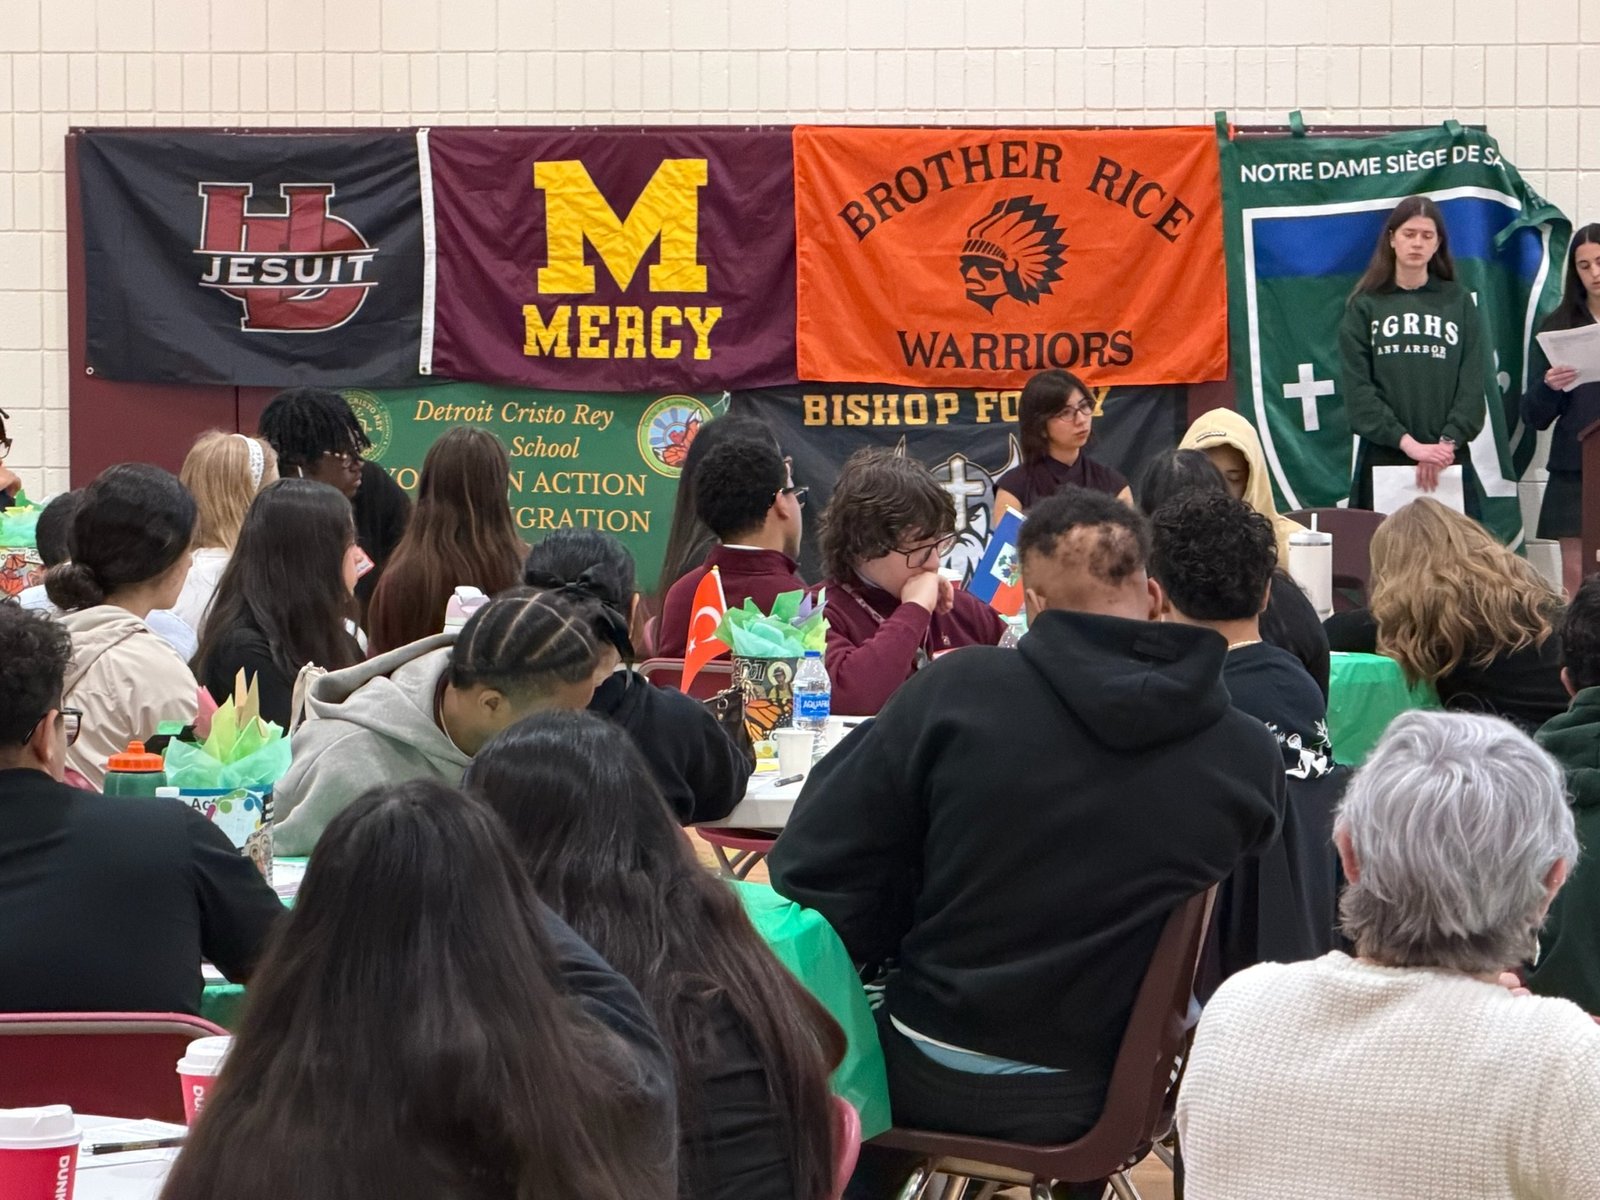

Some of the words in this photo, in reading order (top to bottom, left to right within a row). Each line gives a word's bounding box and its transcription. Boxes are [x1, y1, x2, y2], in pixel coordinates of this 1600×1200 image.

[1240, 162, 1314, 184] NOTRE
[1318, 157, 1382, 180] DAME
[1386, 148, 1448, 174] SIÈGE
[1452, 145, 1480, 165] DE
[838, 140, 1064, 243] BROTHER
[1086, 156, 1195, 243] RICE
[533, 158, 708, 294] M
[201, 254, 374, 284] JESUIT
[522, 304, 723, 360] MERCY
[896, 329, 1135, 371] WARRIORS
[1377, 344, 1400, 355] ANN
[1404, 344, 1447, 355] ARBOR
[413, 399, 494, 423] Detroit
[501, 401, 566, 425] Cristo
[571, 404, 614, 431] Rey
[803, 392, 960, 426] BISHOP
[509, 435, 581, 459] School
[531, 471, 648, 496] ACTION
[510, 506, 651, 533] GRATION
